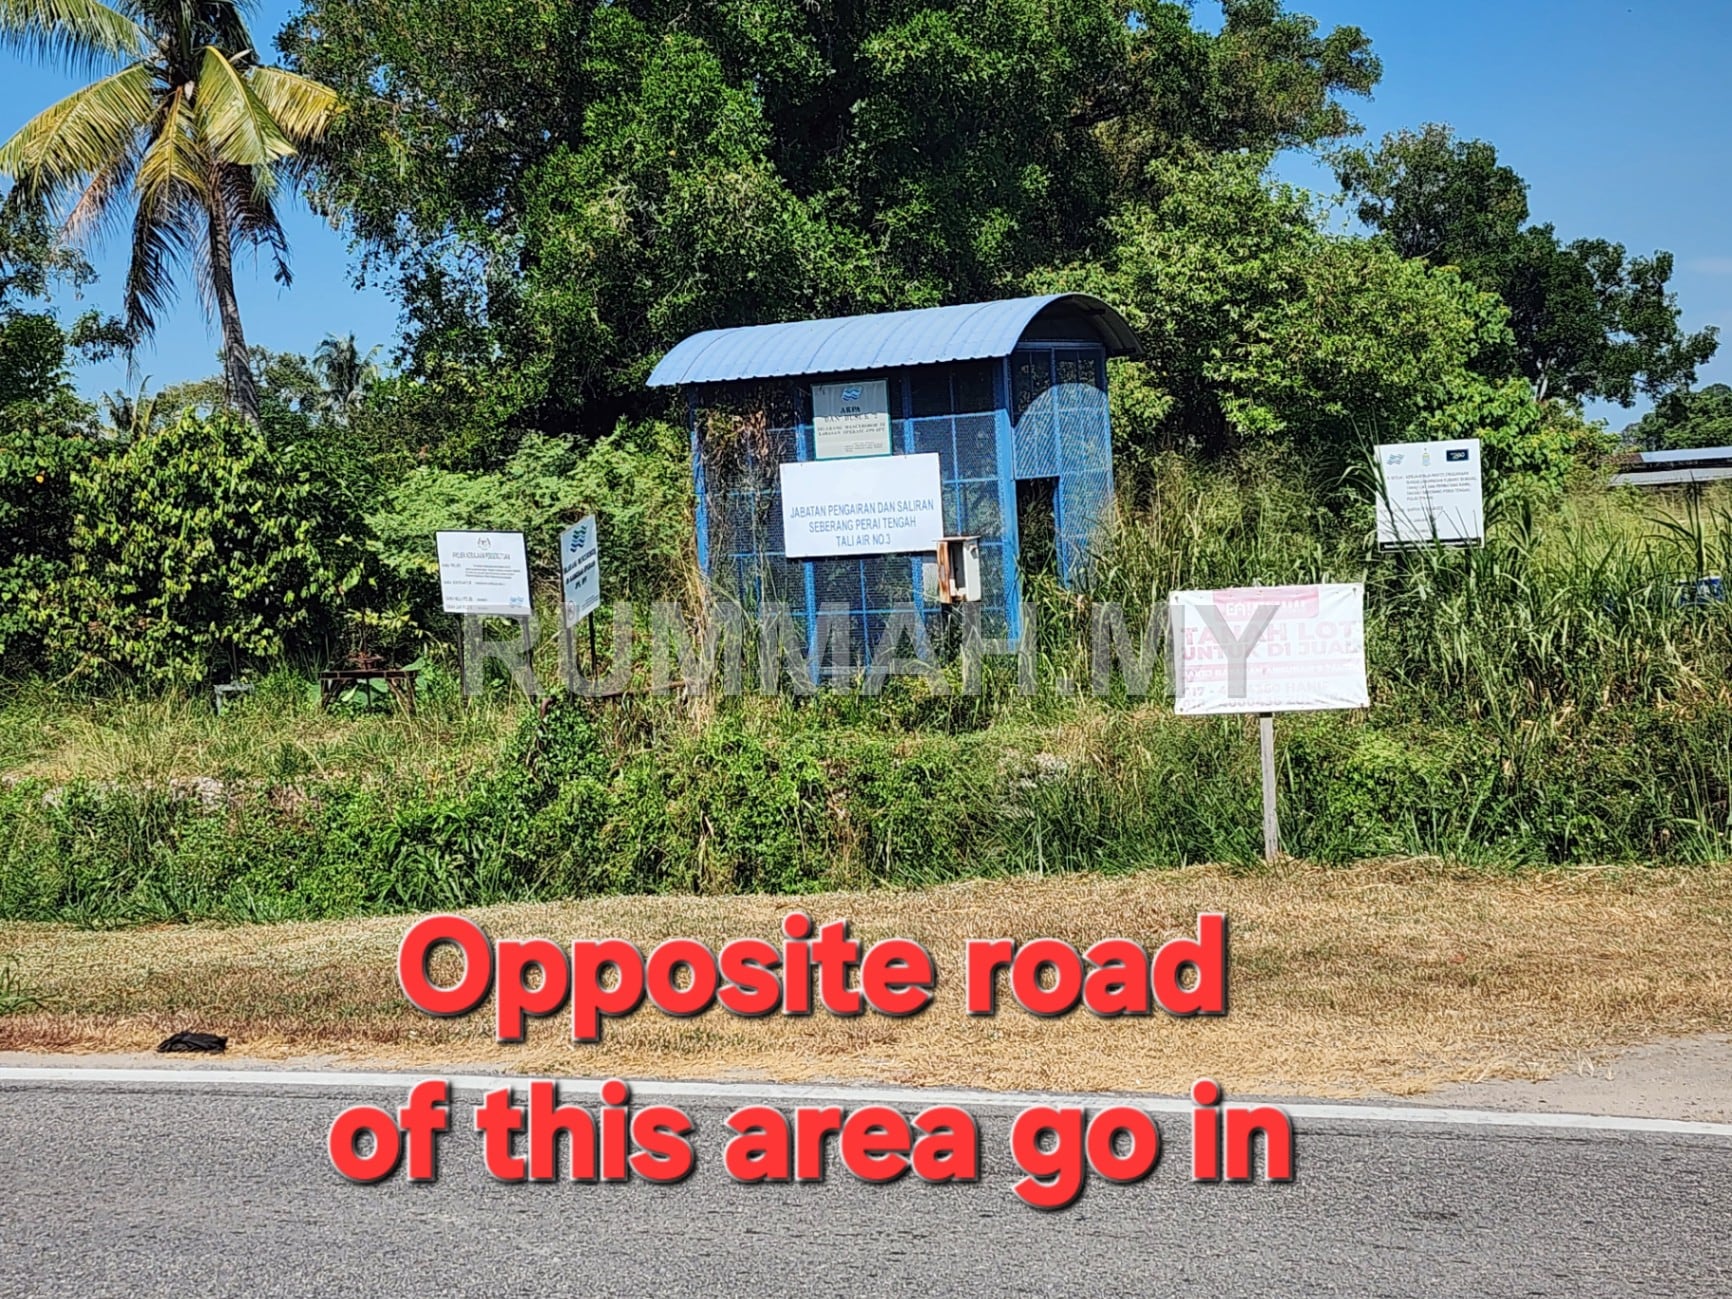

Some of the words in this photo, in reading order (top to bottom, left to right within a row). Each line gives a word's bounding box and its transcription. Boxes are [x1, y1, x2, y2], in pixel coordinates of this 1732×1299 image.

[790, 505, 827, 519] JABATAN
[828, 501, 876, 517] PENGAIRAN
[877, 500, 896, 514] DAN
[896, 498, 935, 513] SALIRAN
[808, 519, 854, 533] SEBERANG
[855, 517, 881, 531] PERAI
[882, 515, 917, 530] TENGAH
[835, 534, 855, 548] TALI
[855, 533, 870, 546] AIR
[1302, 620, 1357, 640] LOT
[1268, 643, 1292, 658] DI
[1300, 638, 1358, 657] JUAL
